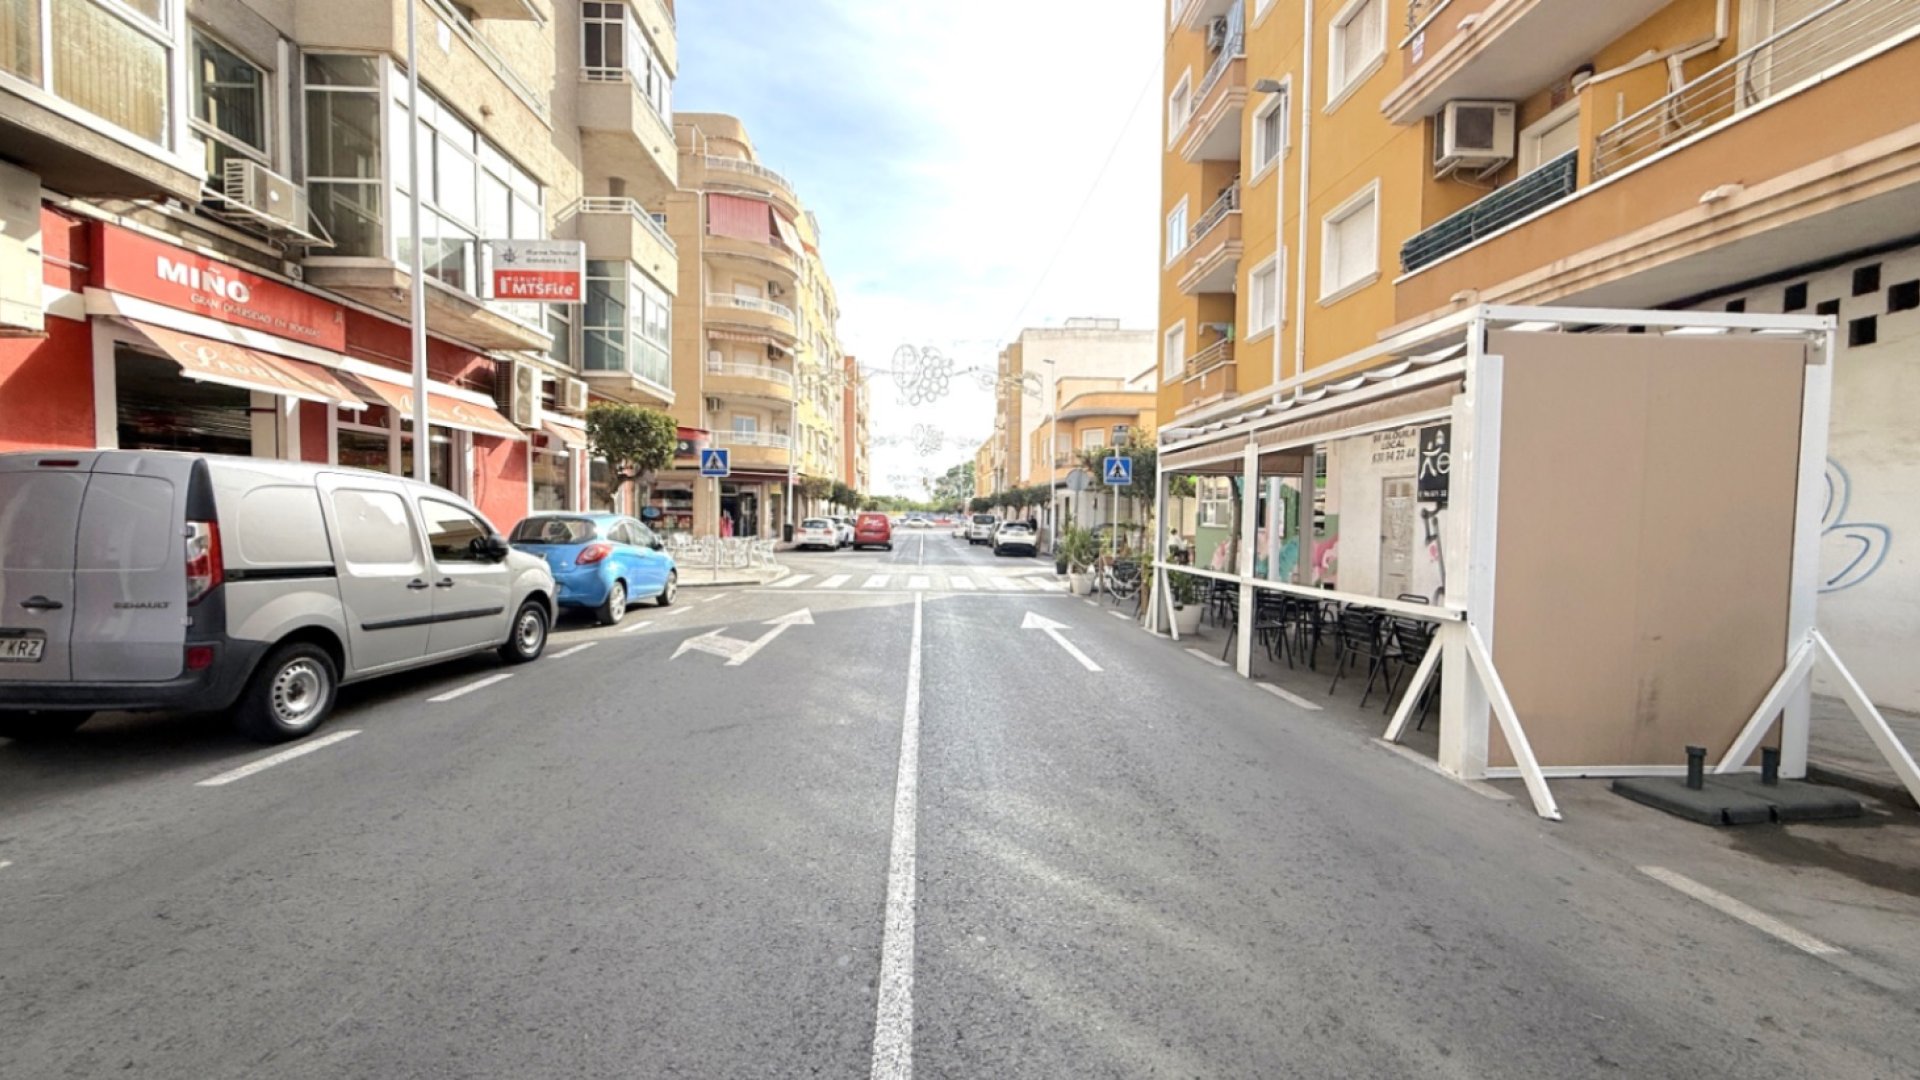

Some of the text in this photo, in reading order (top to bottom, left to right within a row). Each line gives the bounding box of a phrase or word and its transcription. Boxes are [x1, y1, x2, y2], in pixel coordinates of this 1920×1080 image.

[157, 255, 250, 303] MIÑO
[512, 282, 574, 296] MTSFire
[7, 641, 40, 657] KRZ
